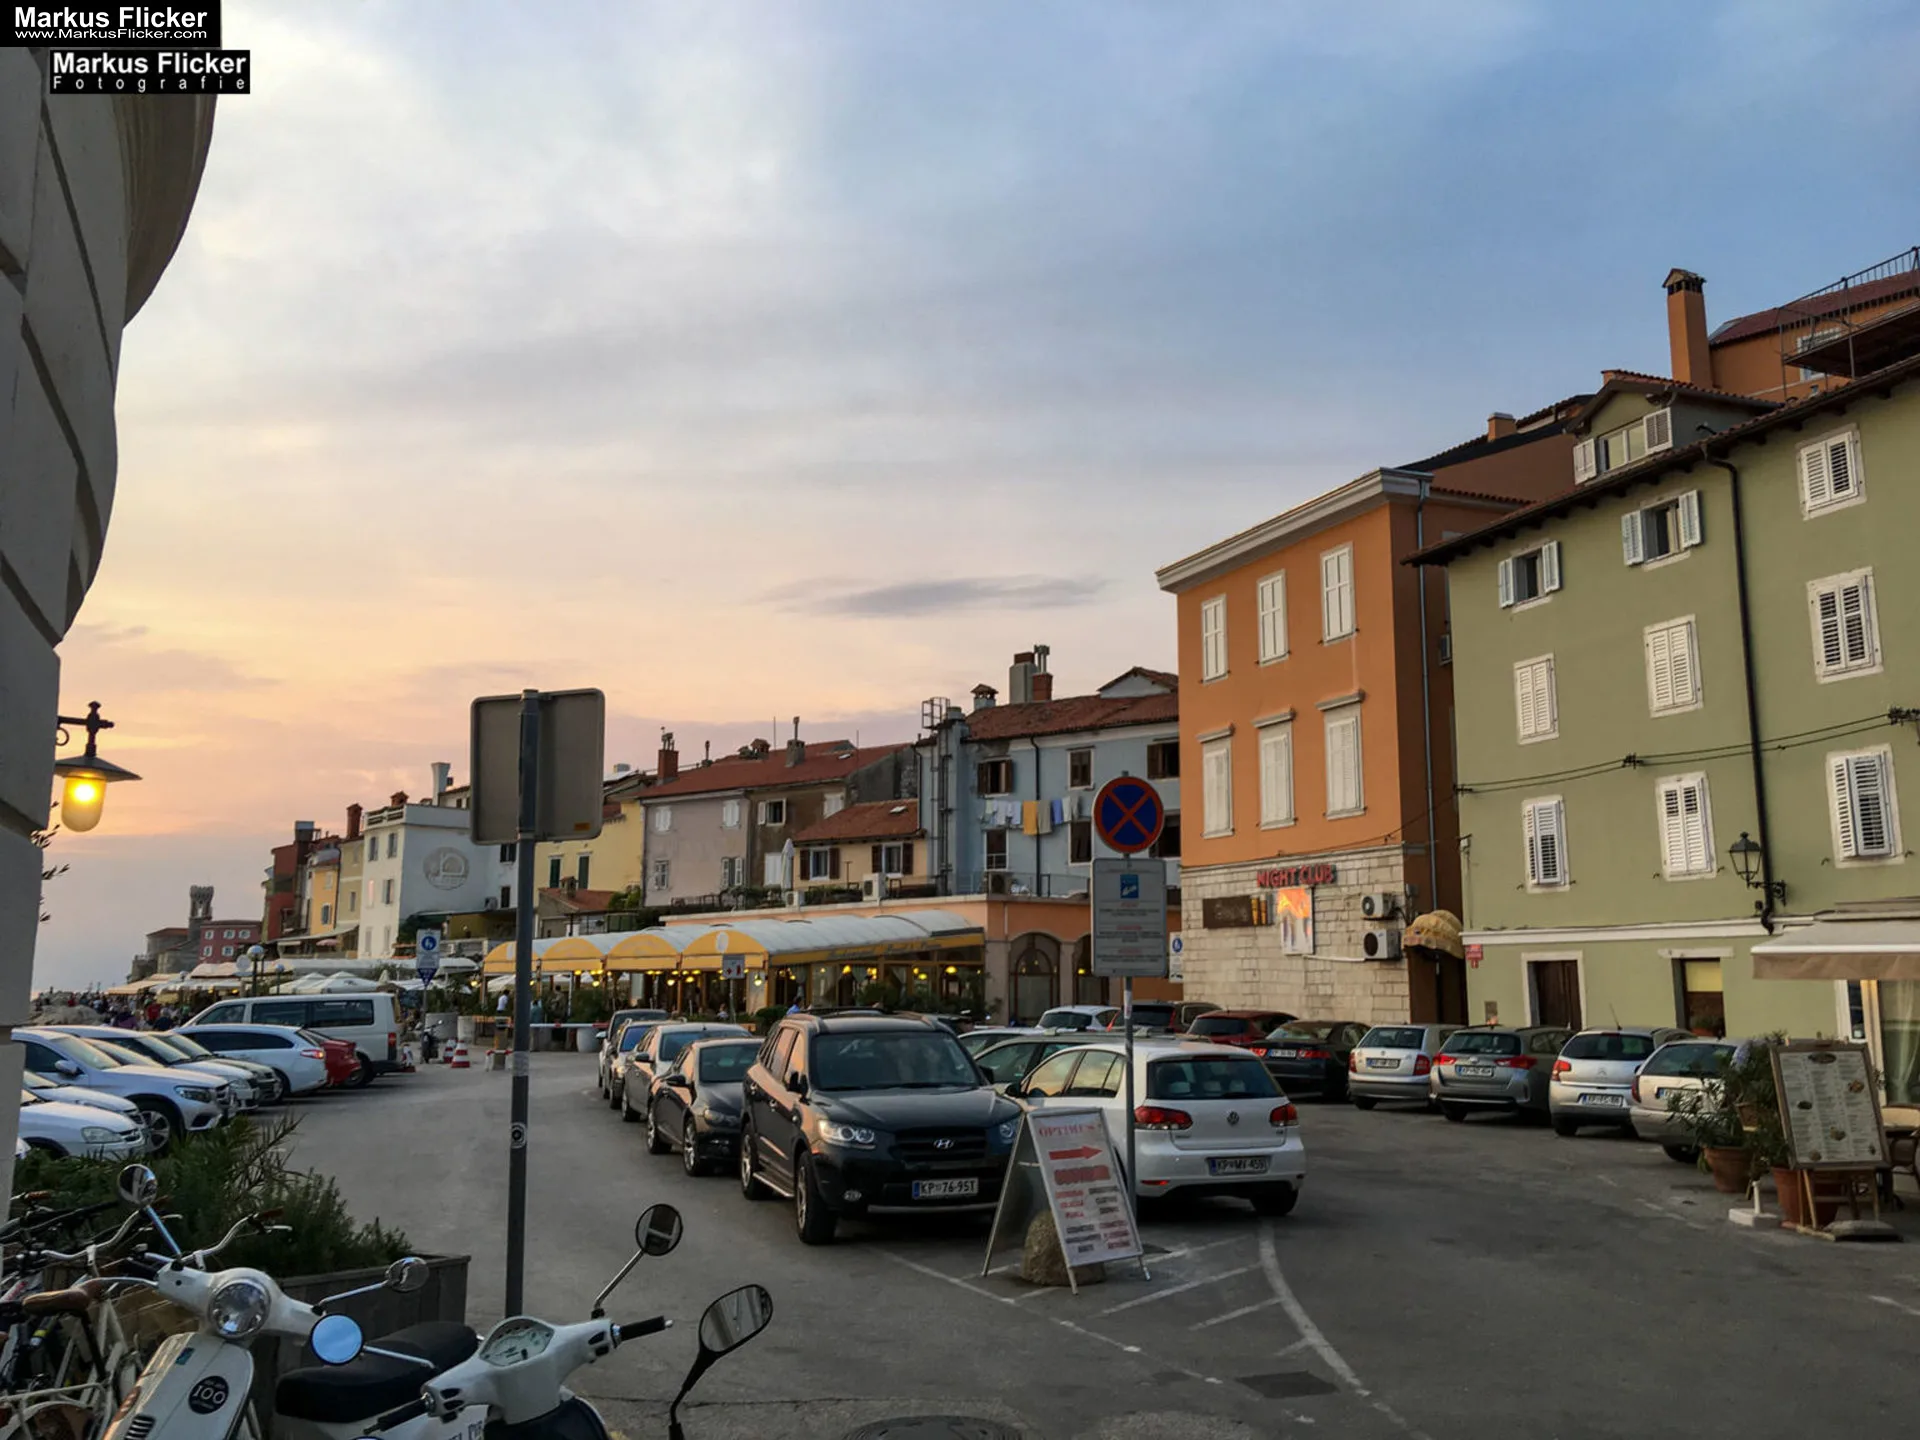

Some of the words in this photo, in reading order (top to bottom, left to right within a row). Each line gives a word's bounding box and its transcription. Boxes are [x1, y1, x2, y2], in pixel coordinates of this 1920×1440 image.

[1256, 867, 1297, 888] NIGHT
[1300, 863, 1336, 885] CLUB
[191, 1384, 226, 1404] 100
